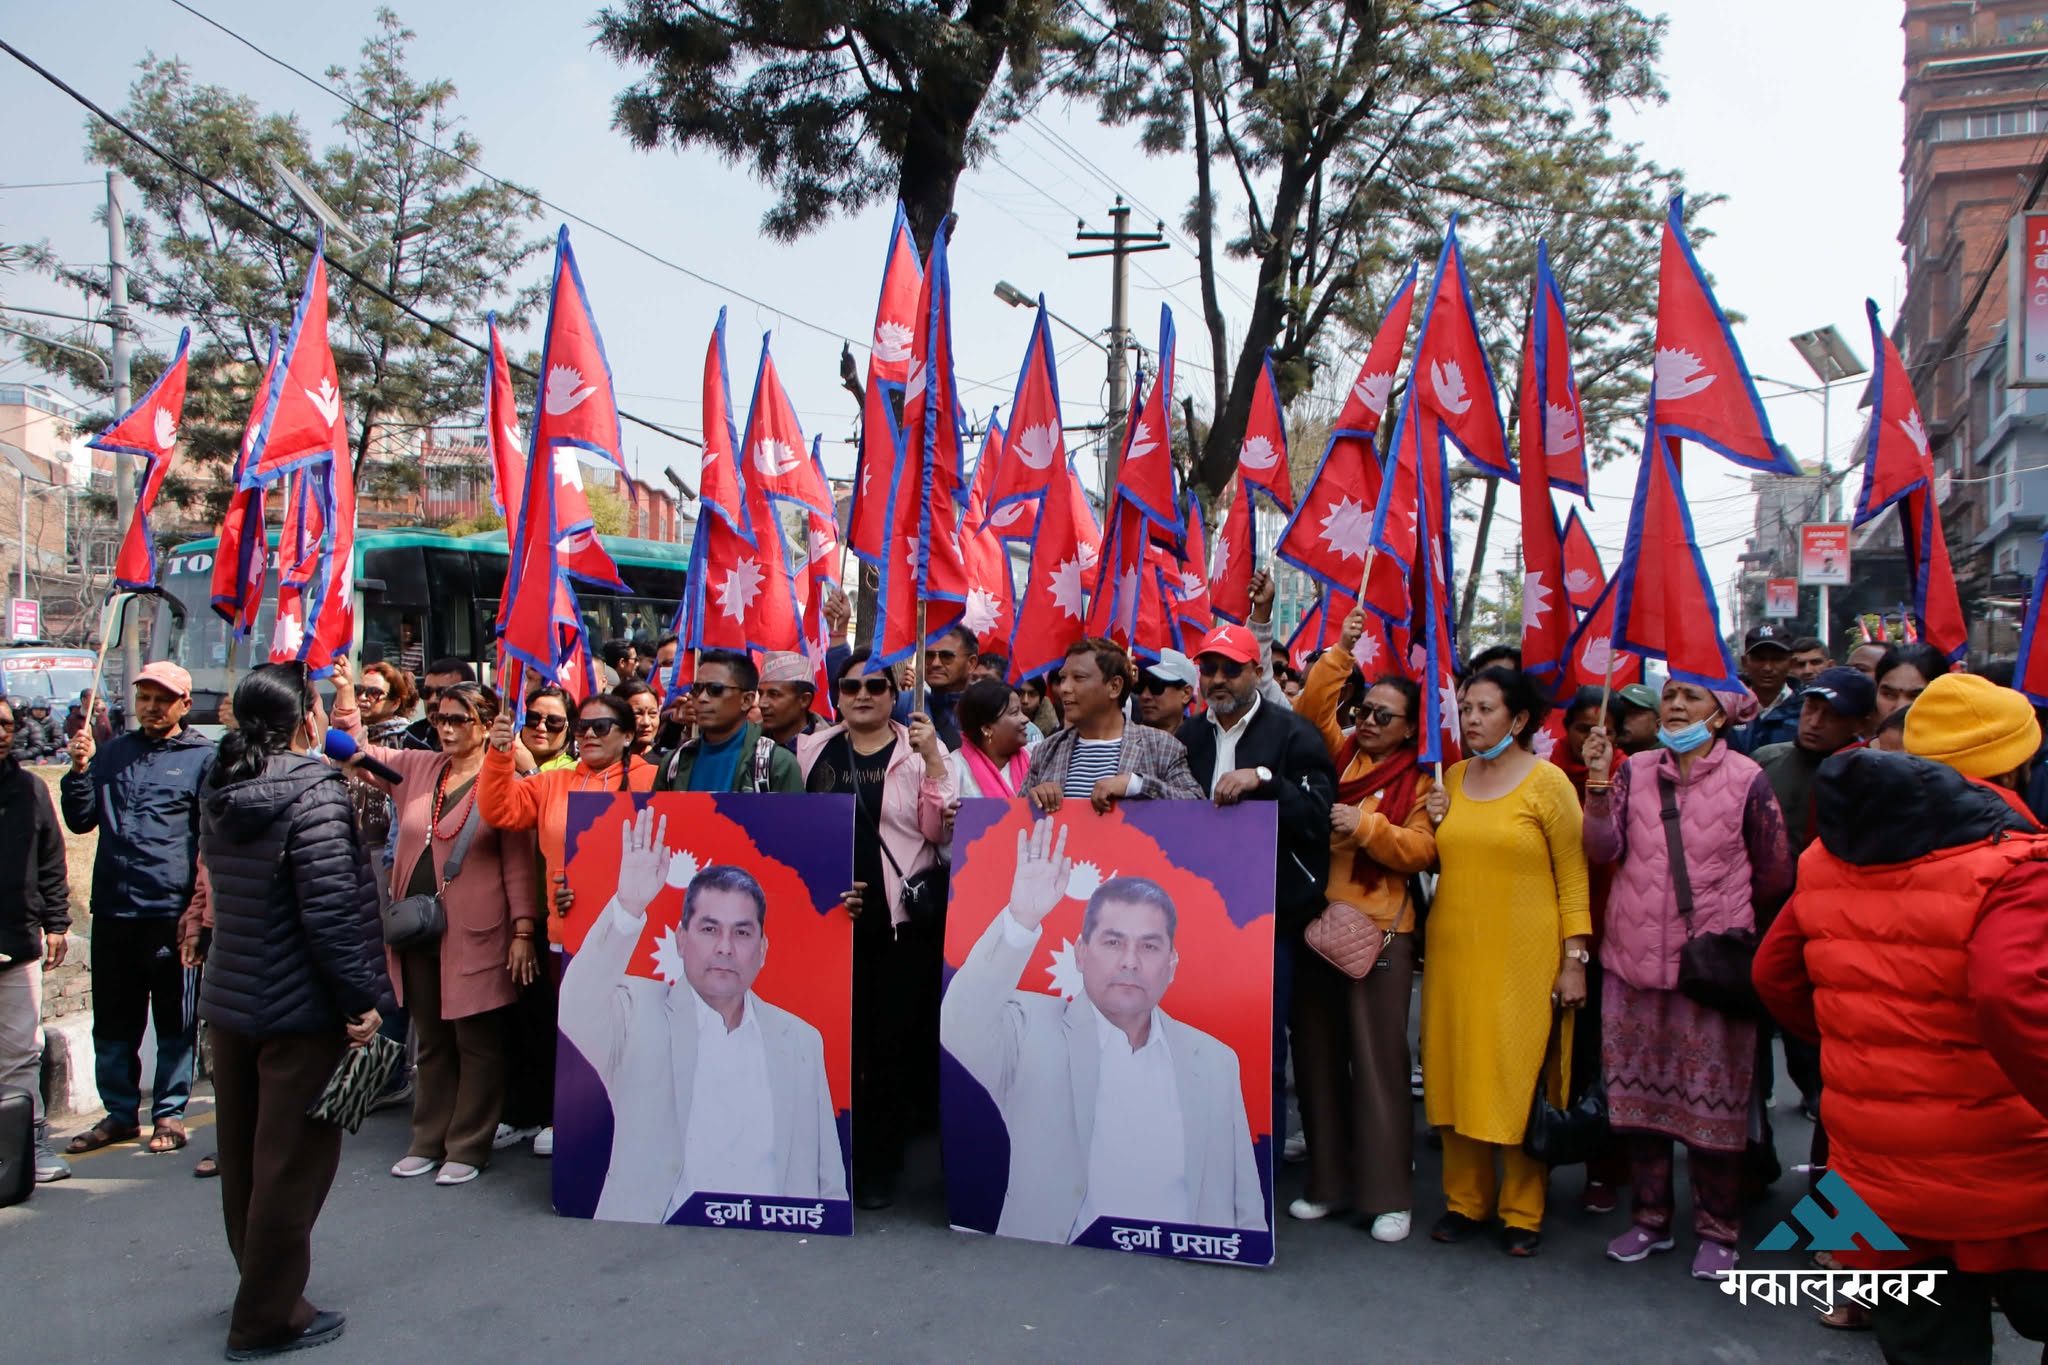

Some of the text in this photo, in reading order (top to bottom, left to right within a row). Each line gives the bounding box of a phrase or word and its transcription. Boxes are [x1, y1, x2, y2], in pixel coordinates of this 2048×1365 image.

[705, 1199, 825, 1229] दुर्गा प्रसाई
[1111, 1225, 1242, 1259] दुर्गा प्रसाई
